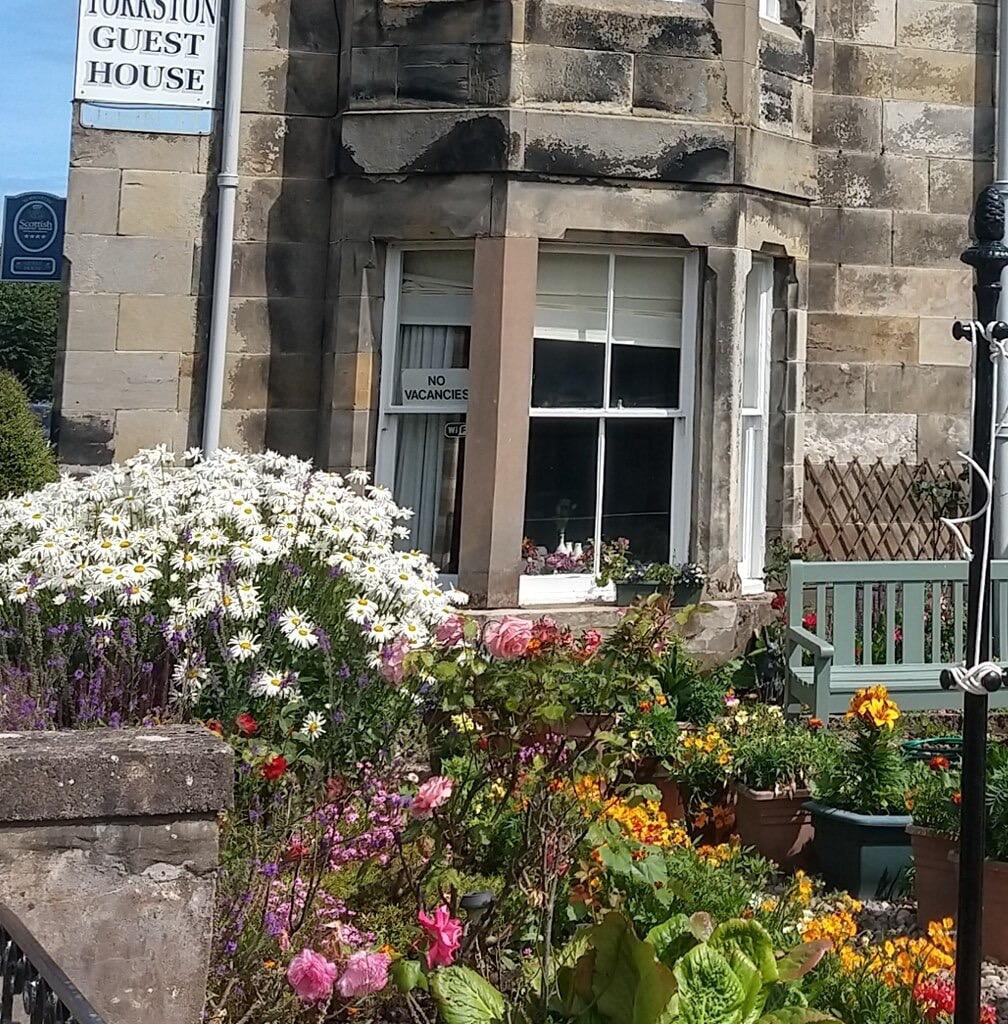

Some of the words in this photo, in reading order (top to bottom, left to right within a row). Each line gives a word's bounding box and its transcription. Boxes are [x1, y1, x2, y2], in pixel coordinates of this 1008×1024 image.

[91, 25, 205, 57] GUEST
[87, 60, 205, 92] HOUSE
[427, 375, 446, 386] NO
[404, 389, 469, 400] VACANCIES
